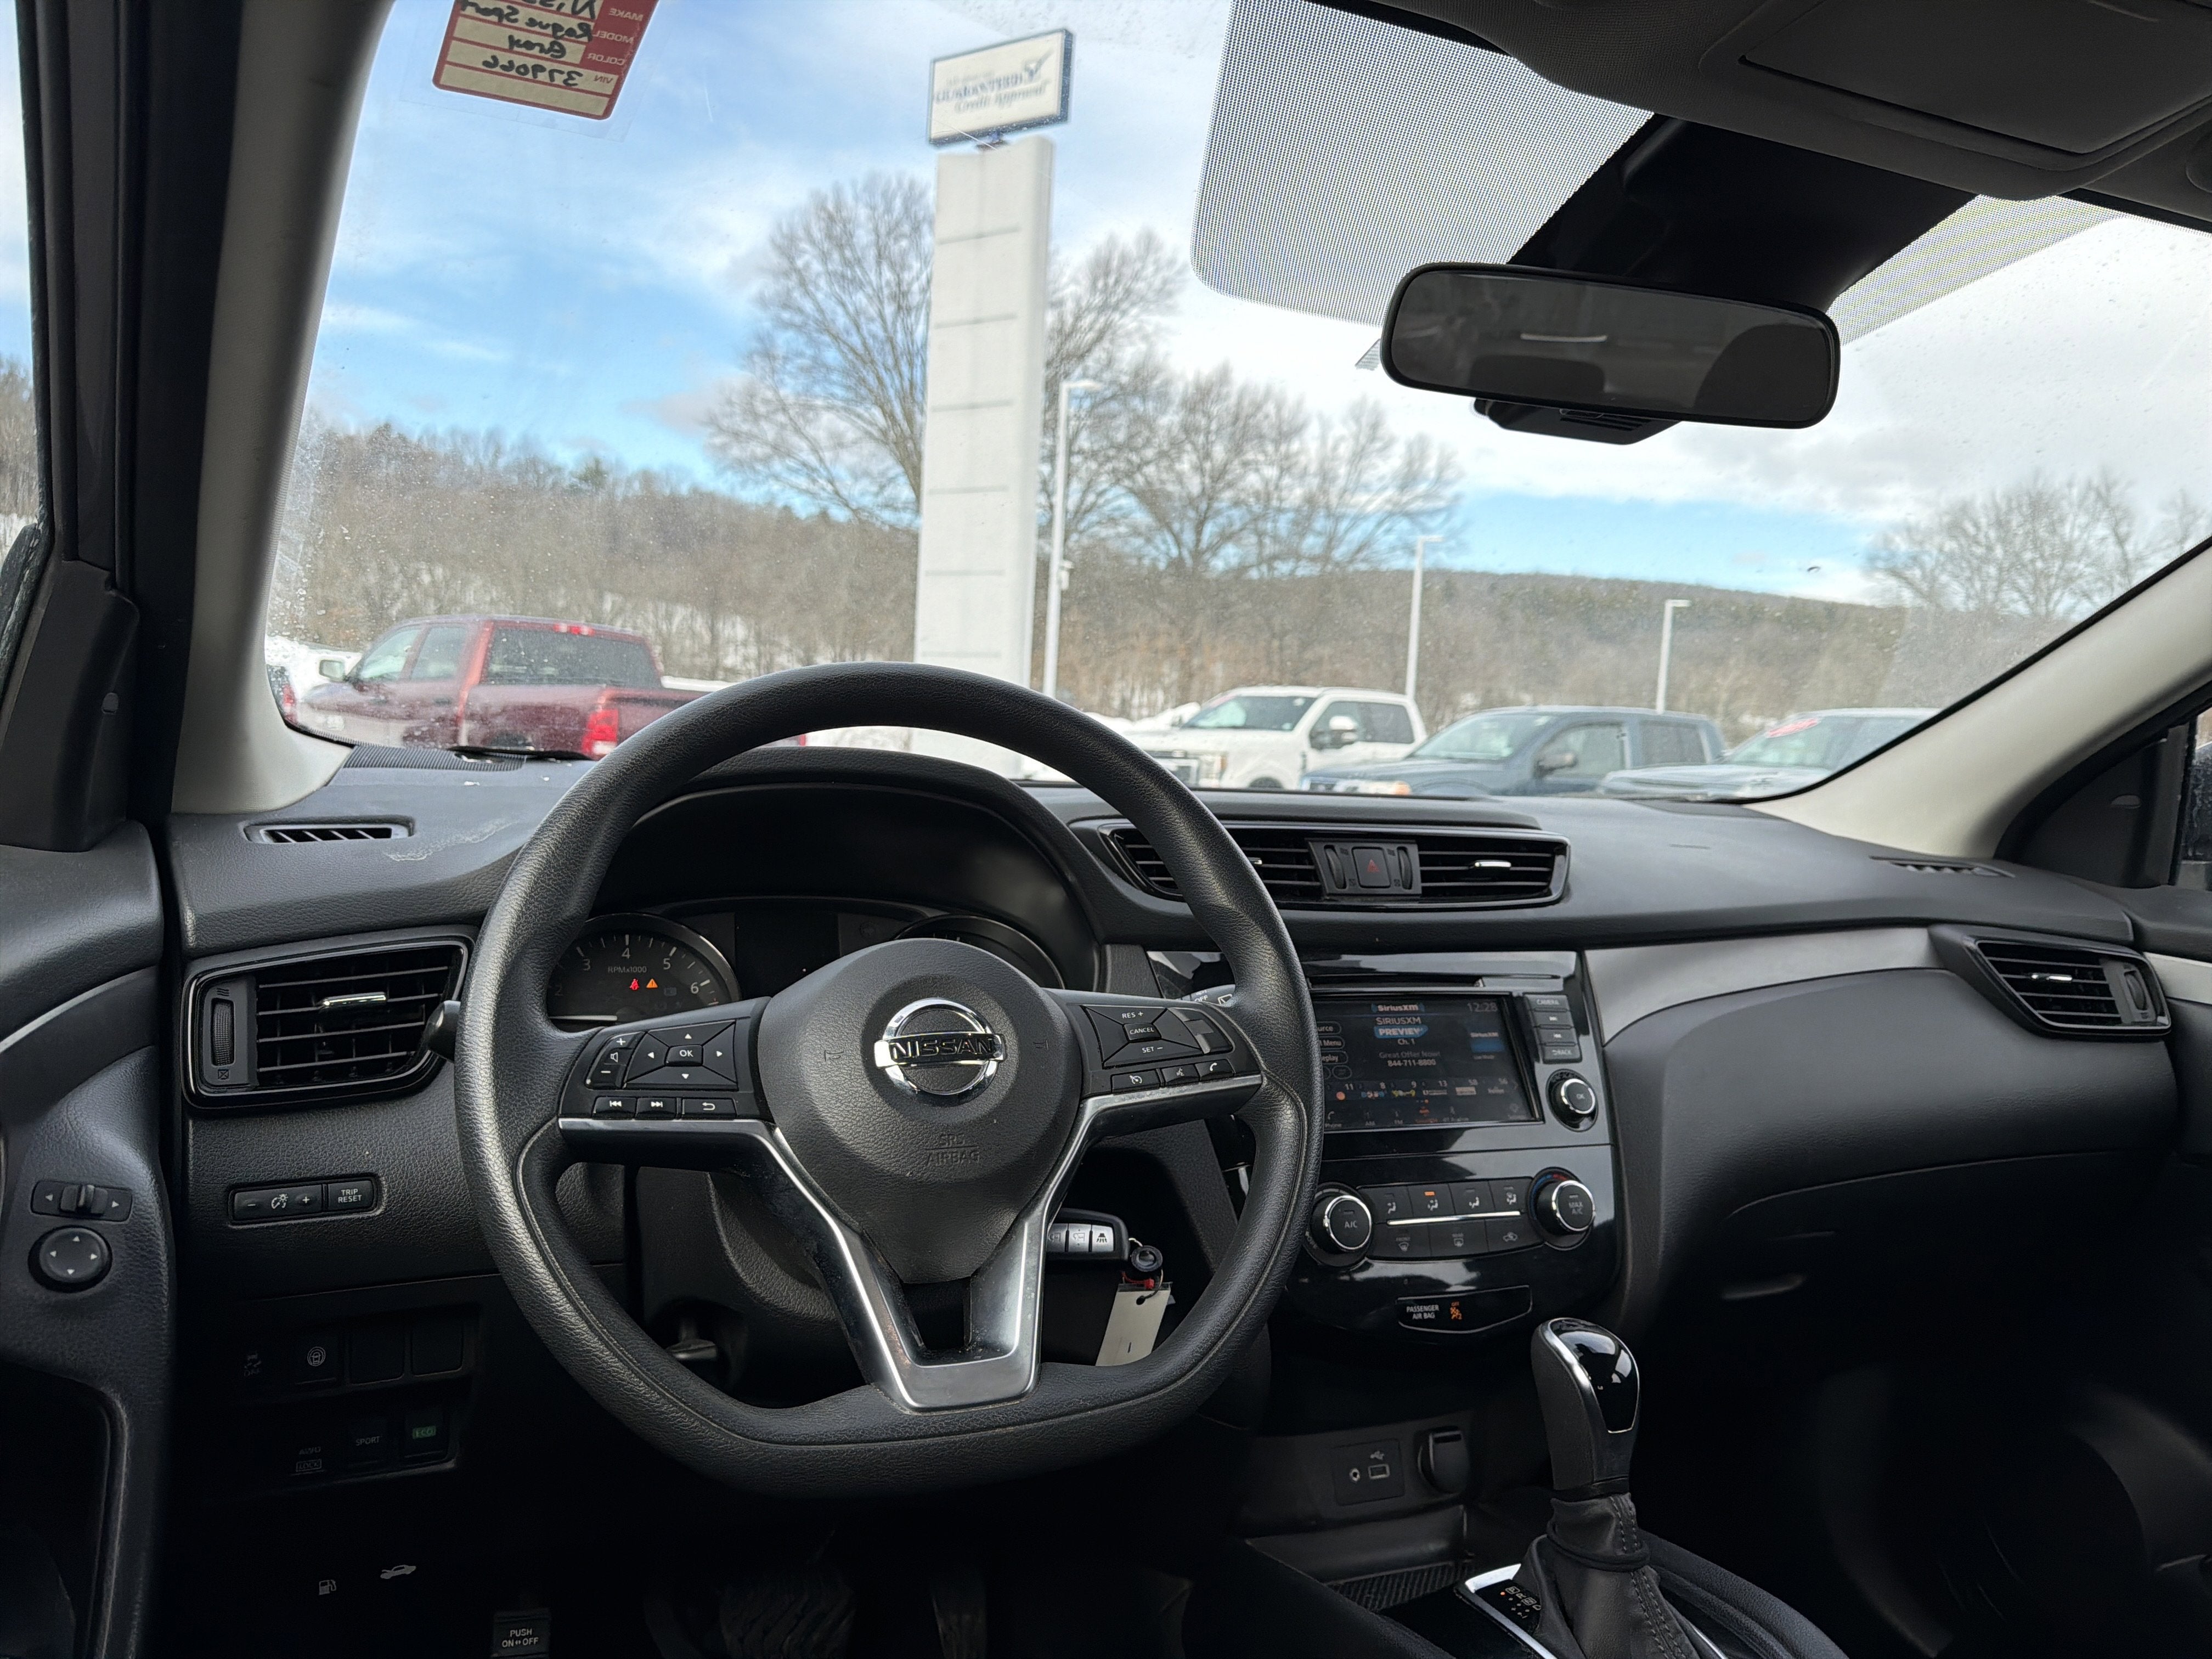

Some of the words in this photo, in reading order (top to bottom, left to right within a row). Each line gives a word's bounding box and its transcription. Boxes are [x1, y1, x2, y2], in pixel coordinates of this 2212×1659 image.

[622, 947, 631, 959] 4
[583, 960, 591, 970] 3
[663, 958, 671, 969] 5
[607, 965, 647, 974] RPMx1000
[690, 982, 699, 994] 6
[1375, 1017, 1421, 1025] SIRIUSXM
[1130, 1027, 1155, 1035] CANCEL
[1379, 1026, 1423, 1036] PREVIEW
[889, 1036, 994, 1059] NISSAN
[679, 1049, 694, 1058] OK
[1322, 1054, 1339, 1063] eplay
[338, 1195, 363, 1203] RESET
[1344, 1220, 1358, 1229] A/C
[1406, 1304, 1440, 1313] PASSENGER
[415, 1427, 435, 1438] ECO
[356, 1435, 381, 1446] SPORT
[510, 1628, 533, 1638] PUSH
[501, 1639, 514, 1648] ON
[522, 1637, 539, 1646] OFF
